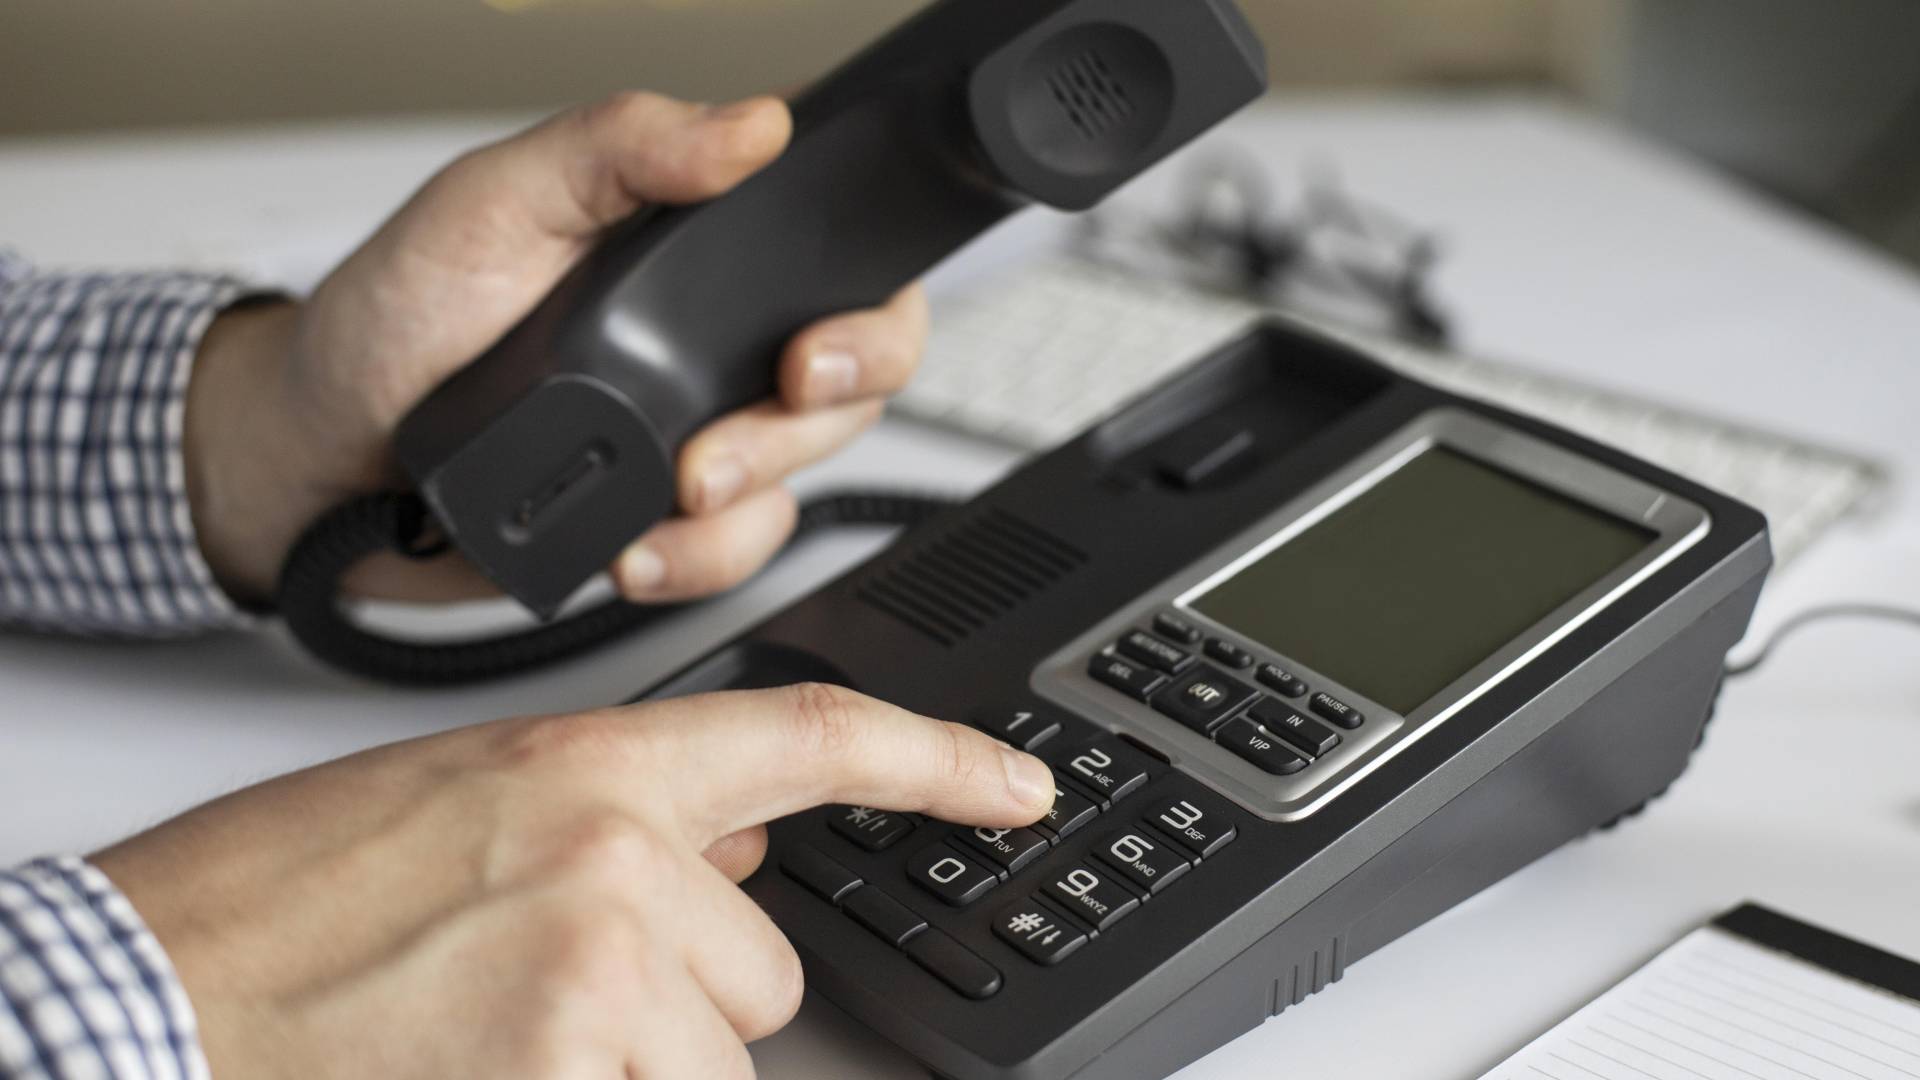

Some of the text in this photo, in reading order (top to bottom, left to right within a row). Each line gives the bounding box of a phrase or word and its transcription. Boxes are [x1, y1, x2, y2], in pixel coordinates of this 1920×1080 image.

[1265, 664, 1292, 681] HOLD
[1316, 693, 1349, 714] PAUSE
[1006, 711, 1033, 731] 1
[1286, 714, 1304, 727] IN
[1248, 736, 1271, 751] VIP
[1070, 748, 1115, 787] 2 ABC
[1159, 800, 1206, 842] 3 DEF
[994, 839, 1015, 853] TUV
[1110, 834, 1156, 877] 6 MNO
[928, 857, 966, 884] 0
[1056, 868, 1109, 915] 9 WXYZ
